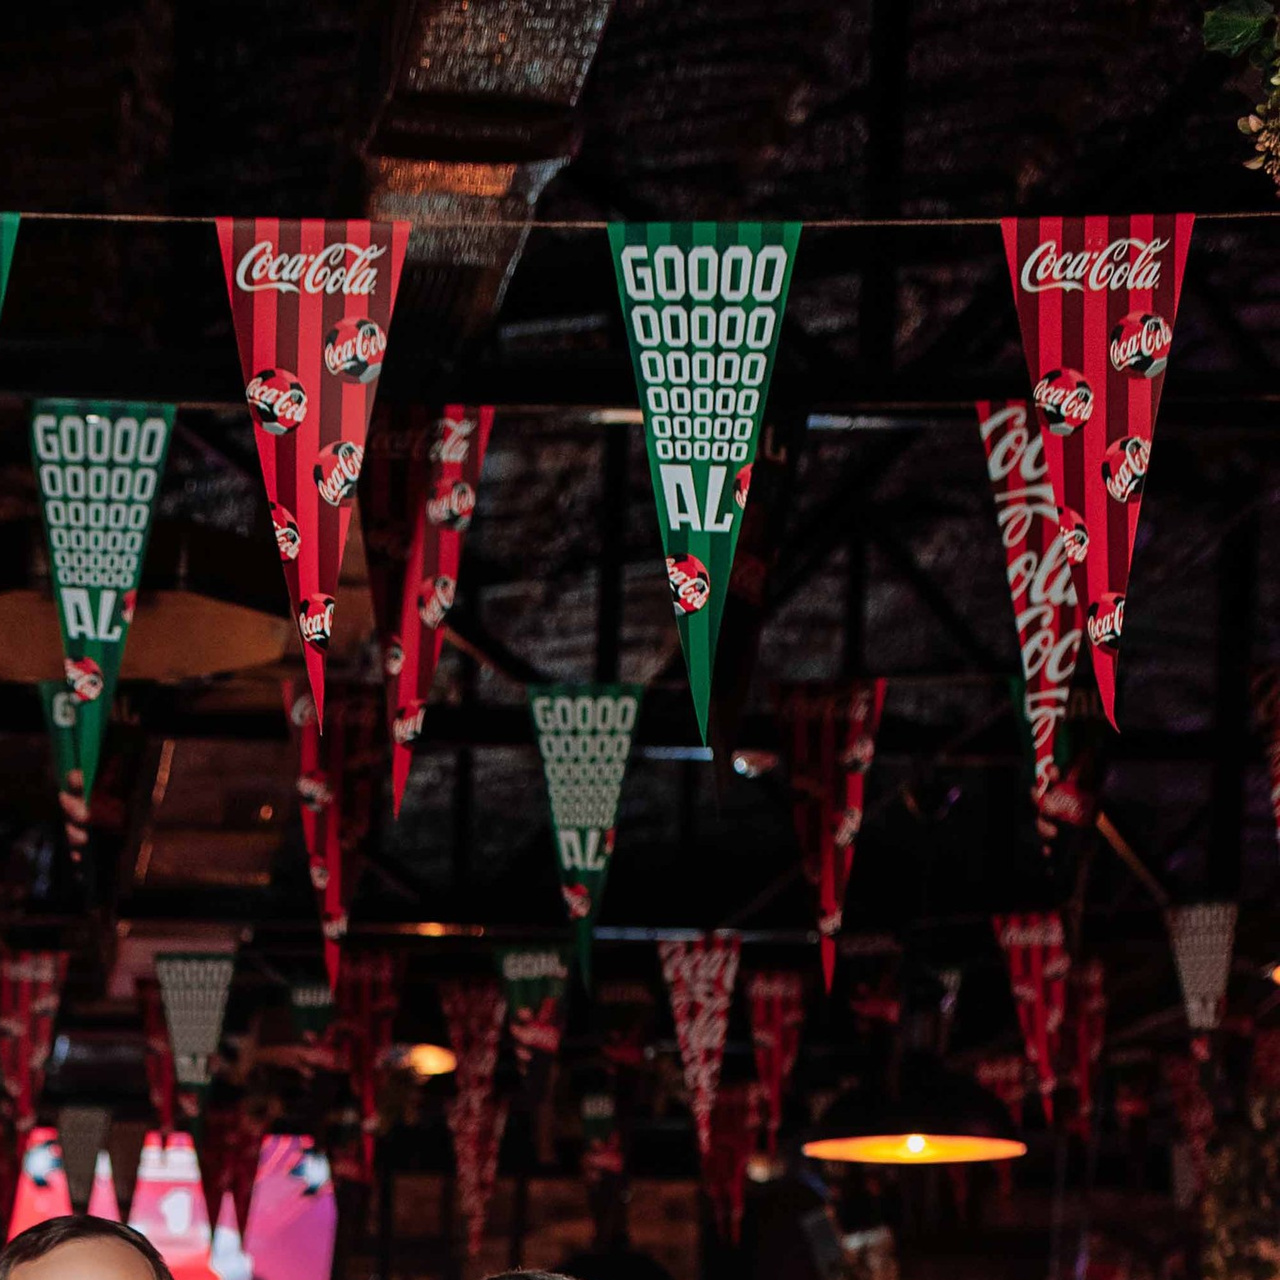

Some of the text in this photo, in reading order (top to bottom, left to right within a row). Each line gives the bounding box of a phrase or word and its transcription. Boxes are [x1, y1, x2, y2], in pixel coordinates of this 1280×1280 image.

[236, 241, 387, 295] Coca-Cola
[621, 245, 788, 302] GOOOO
[1021, 237, 1170, 293] Coca-Cola
[33, 414, 168, 464] GOOOO
[659, 464, 734, 532] AL
[60, 587, 122, 641] AL
